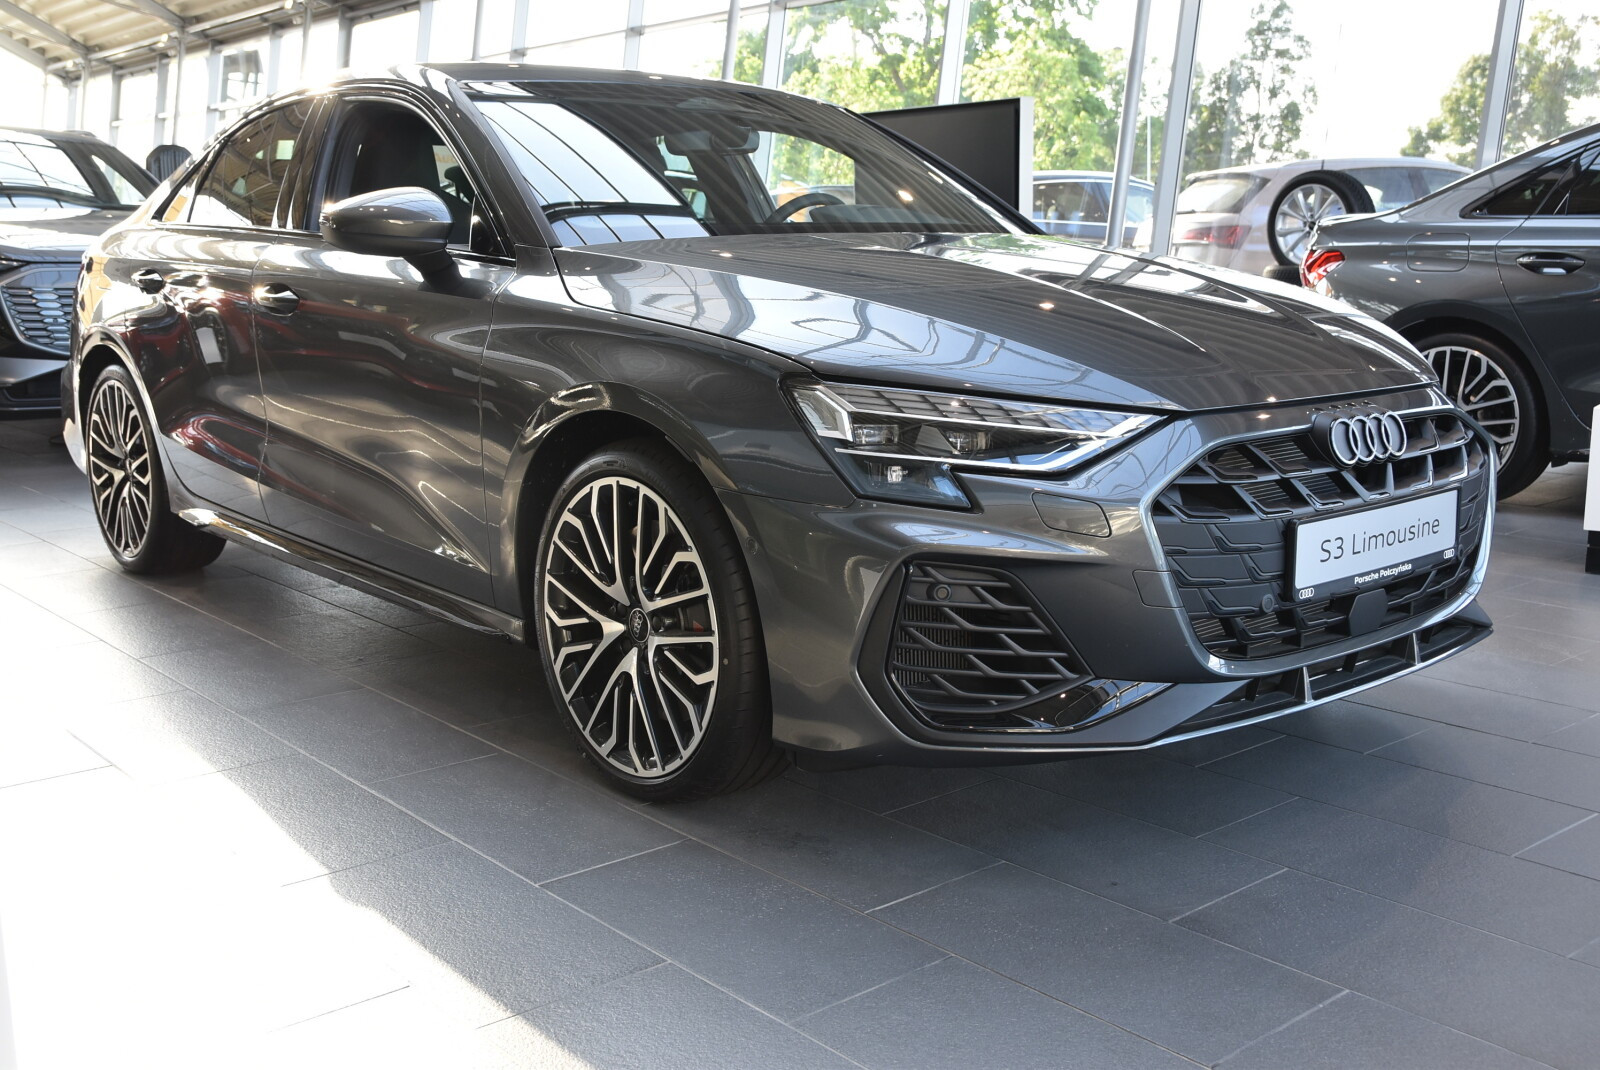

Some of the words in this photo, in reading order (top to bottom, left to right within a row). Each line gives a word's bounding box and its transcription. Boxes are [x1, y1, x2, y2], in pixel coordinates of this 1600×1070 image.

[1320, 536, 1344, 563] S3
[1352, 518, 1440, 556] Limousine
[1354, 572, 1379, 585] Porsche
